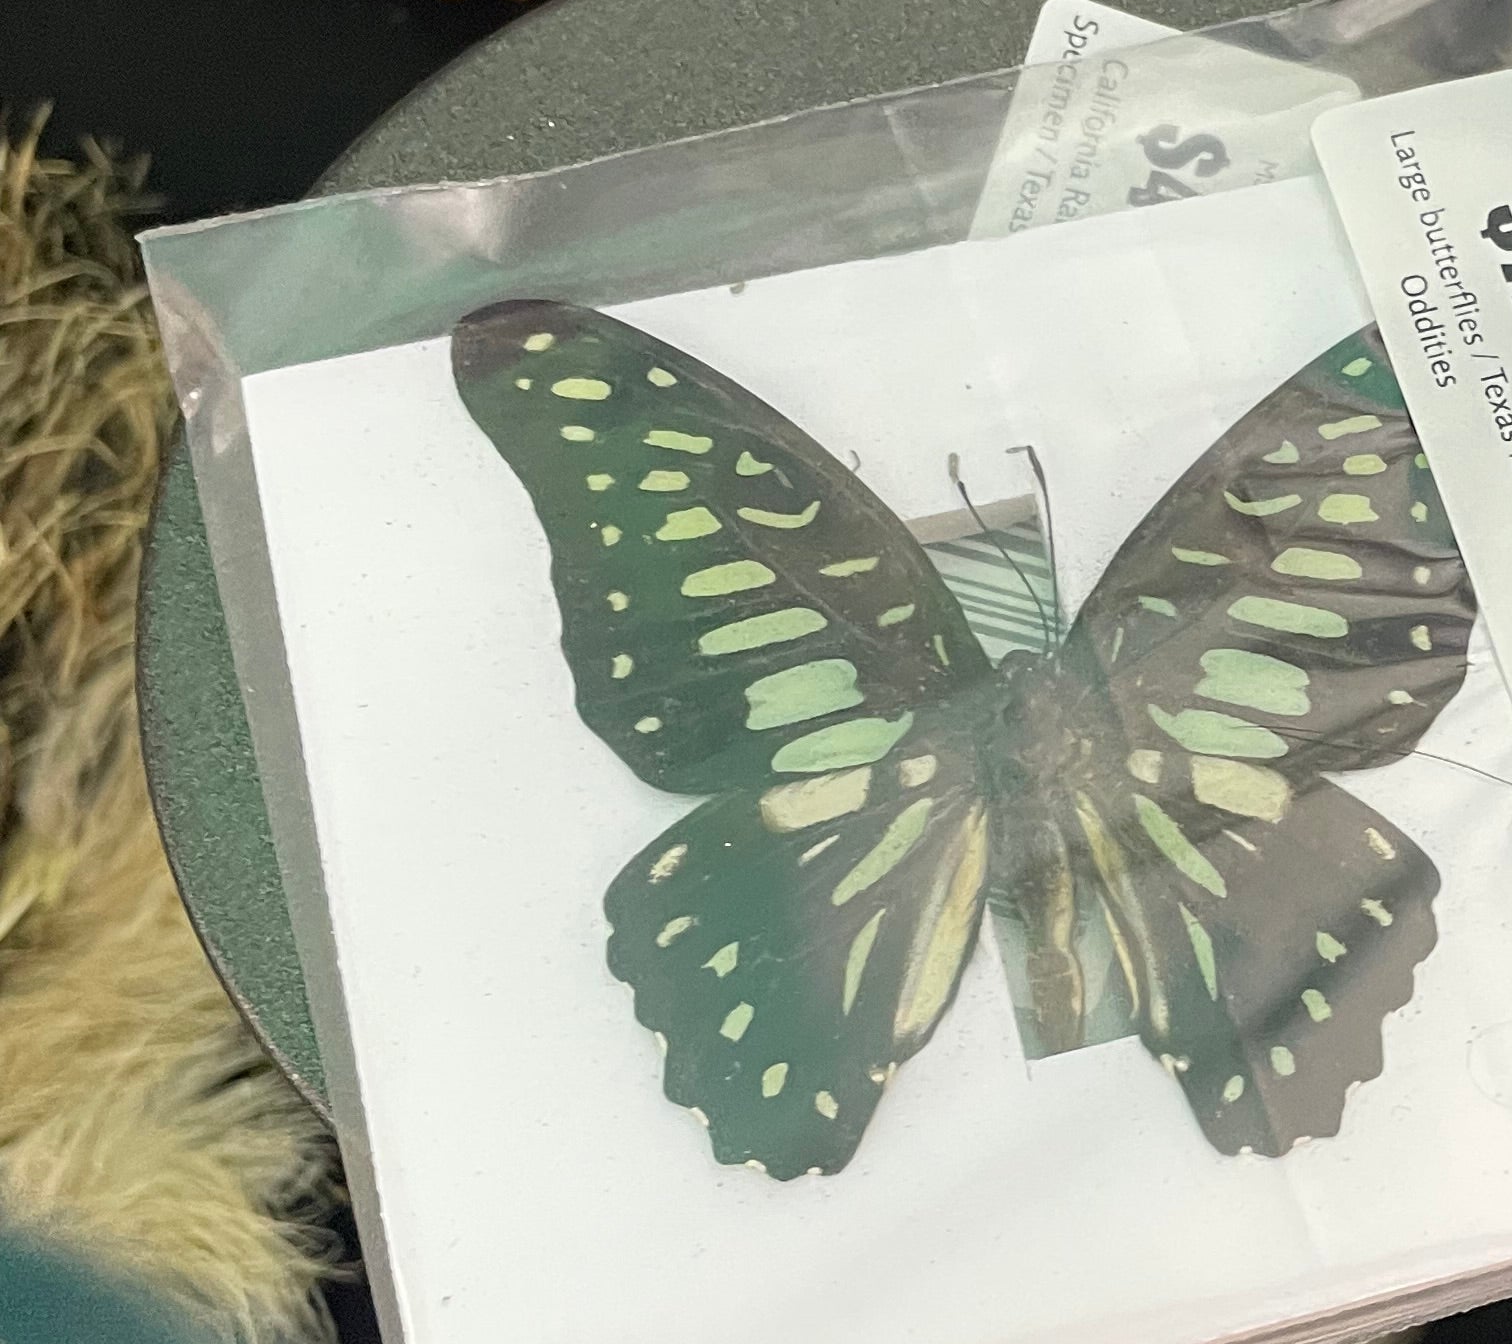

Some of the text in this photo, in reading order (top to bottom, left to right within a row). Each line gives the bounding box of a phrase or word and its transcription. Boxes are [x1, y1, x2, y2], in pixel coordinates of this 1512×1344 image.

[1041, 16, 1099, 143] Specimen
[1066, 59, 1129, 181] California
[1390, 130, 1431, 203] Large
[1419, 208, 1484, 346] butterflies
[1400, 274, 1457, 389] Oddities
